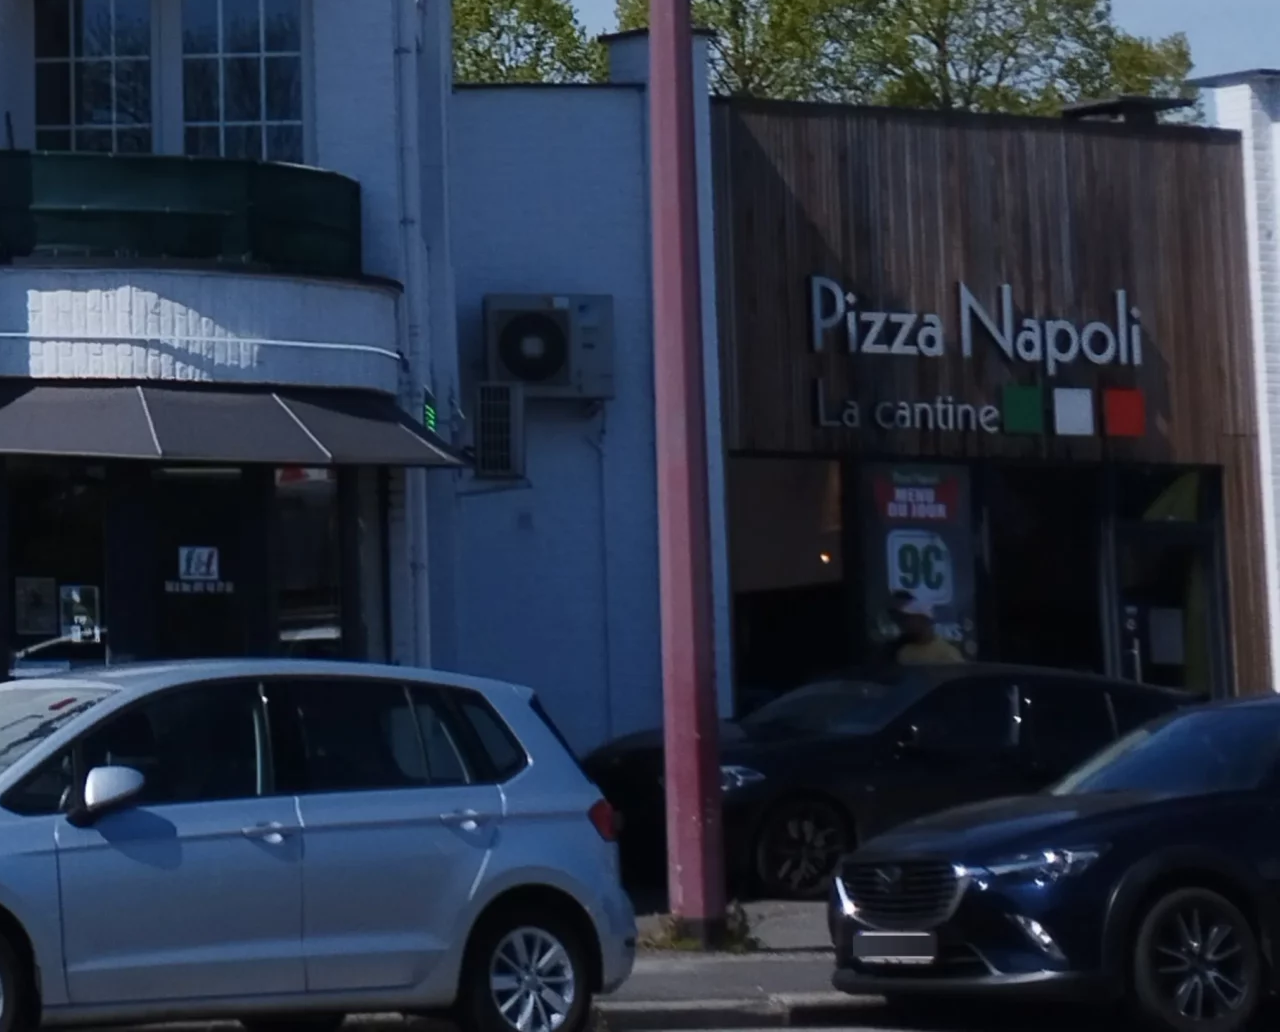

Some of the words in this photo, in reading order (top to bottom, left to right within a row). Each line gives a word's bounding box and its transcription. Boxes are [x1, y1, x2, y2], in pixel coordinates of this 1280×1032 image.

[810, 276, 944, 357] Pizza
[959, 280, 1143, 376] Napoli
[817, 378, 860, 428] La
[874, 395, 1001, 433] cantine
